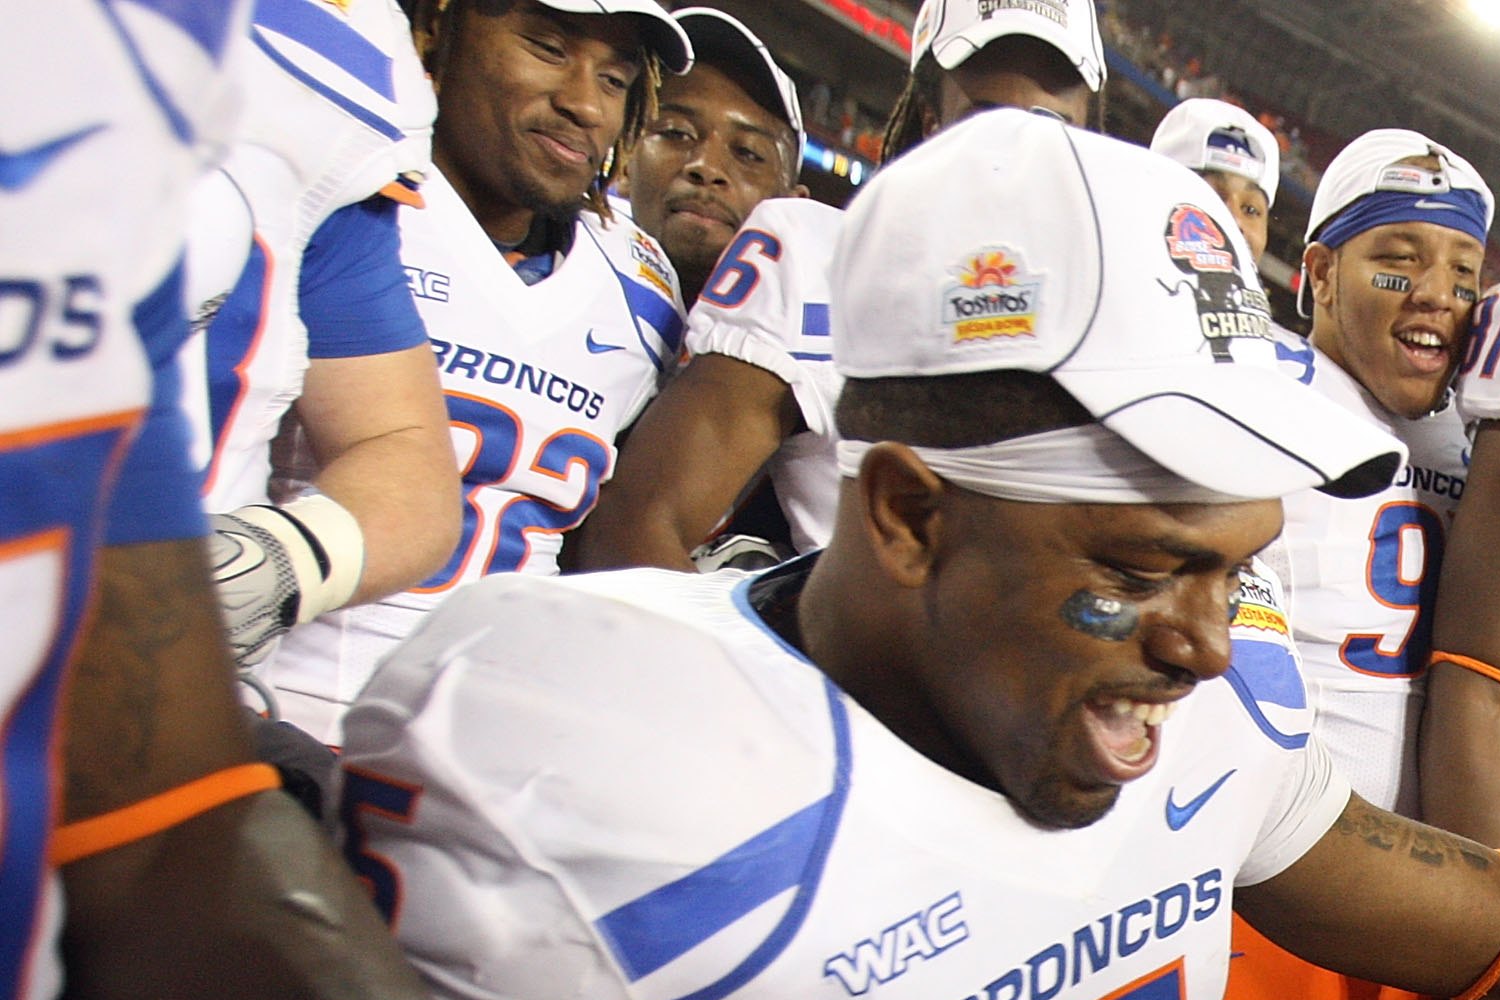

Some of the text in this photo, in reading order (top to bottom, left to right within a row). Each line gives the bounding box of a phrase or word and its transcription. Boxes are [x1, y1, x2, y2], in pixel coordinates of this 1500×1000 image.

[402, 265, 450, 303] AC
[700, 228, 783, 309] 6
[823, 889, 971, 998] WAC
